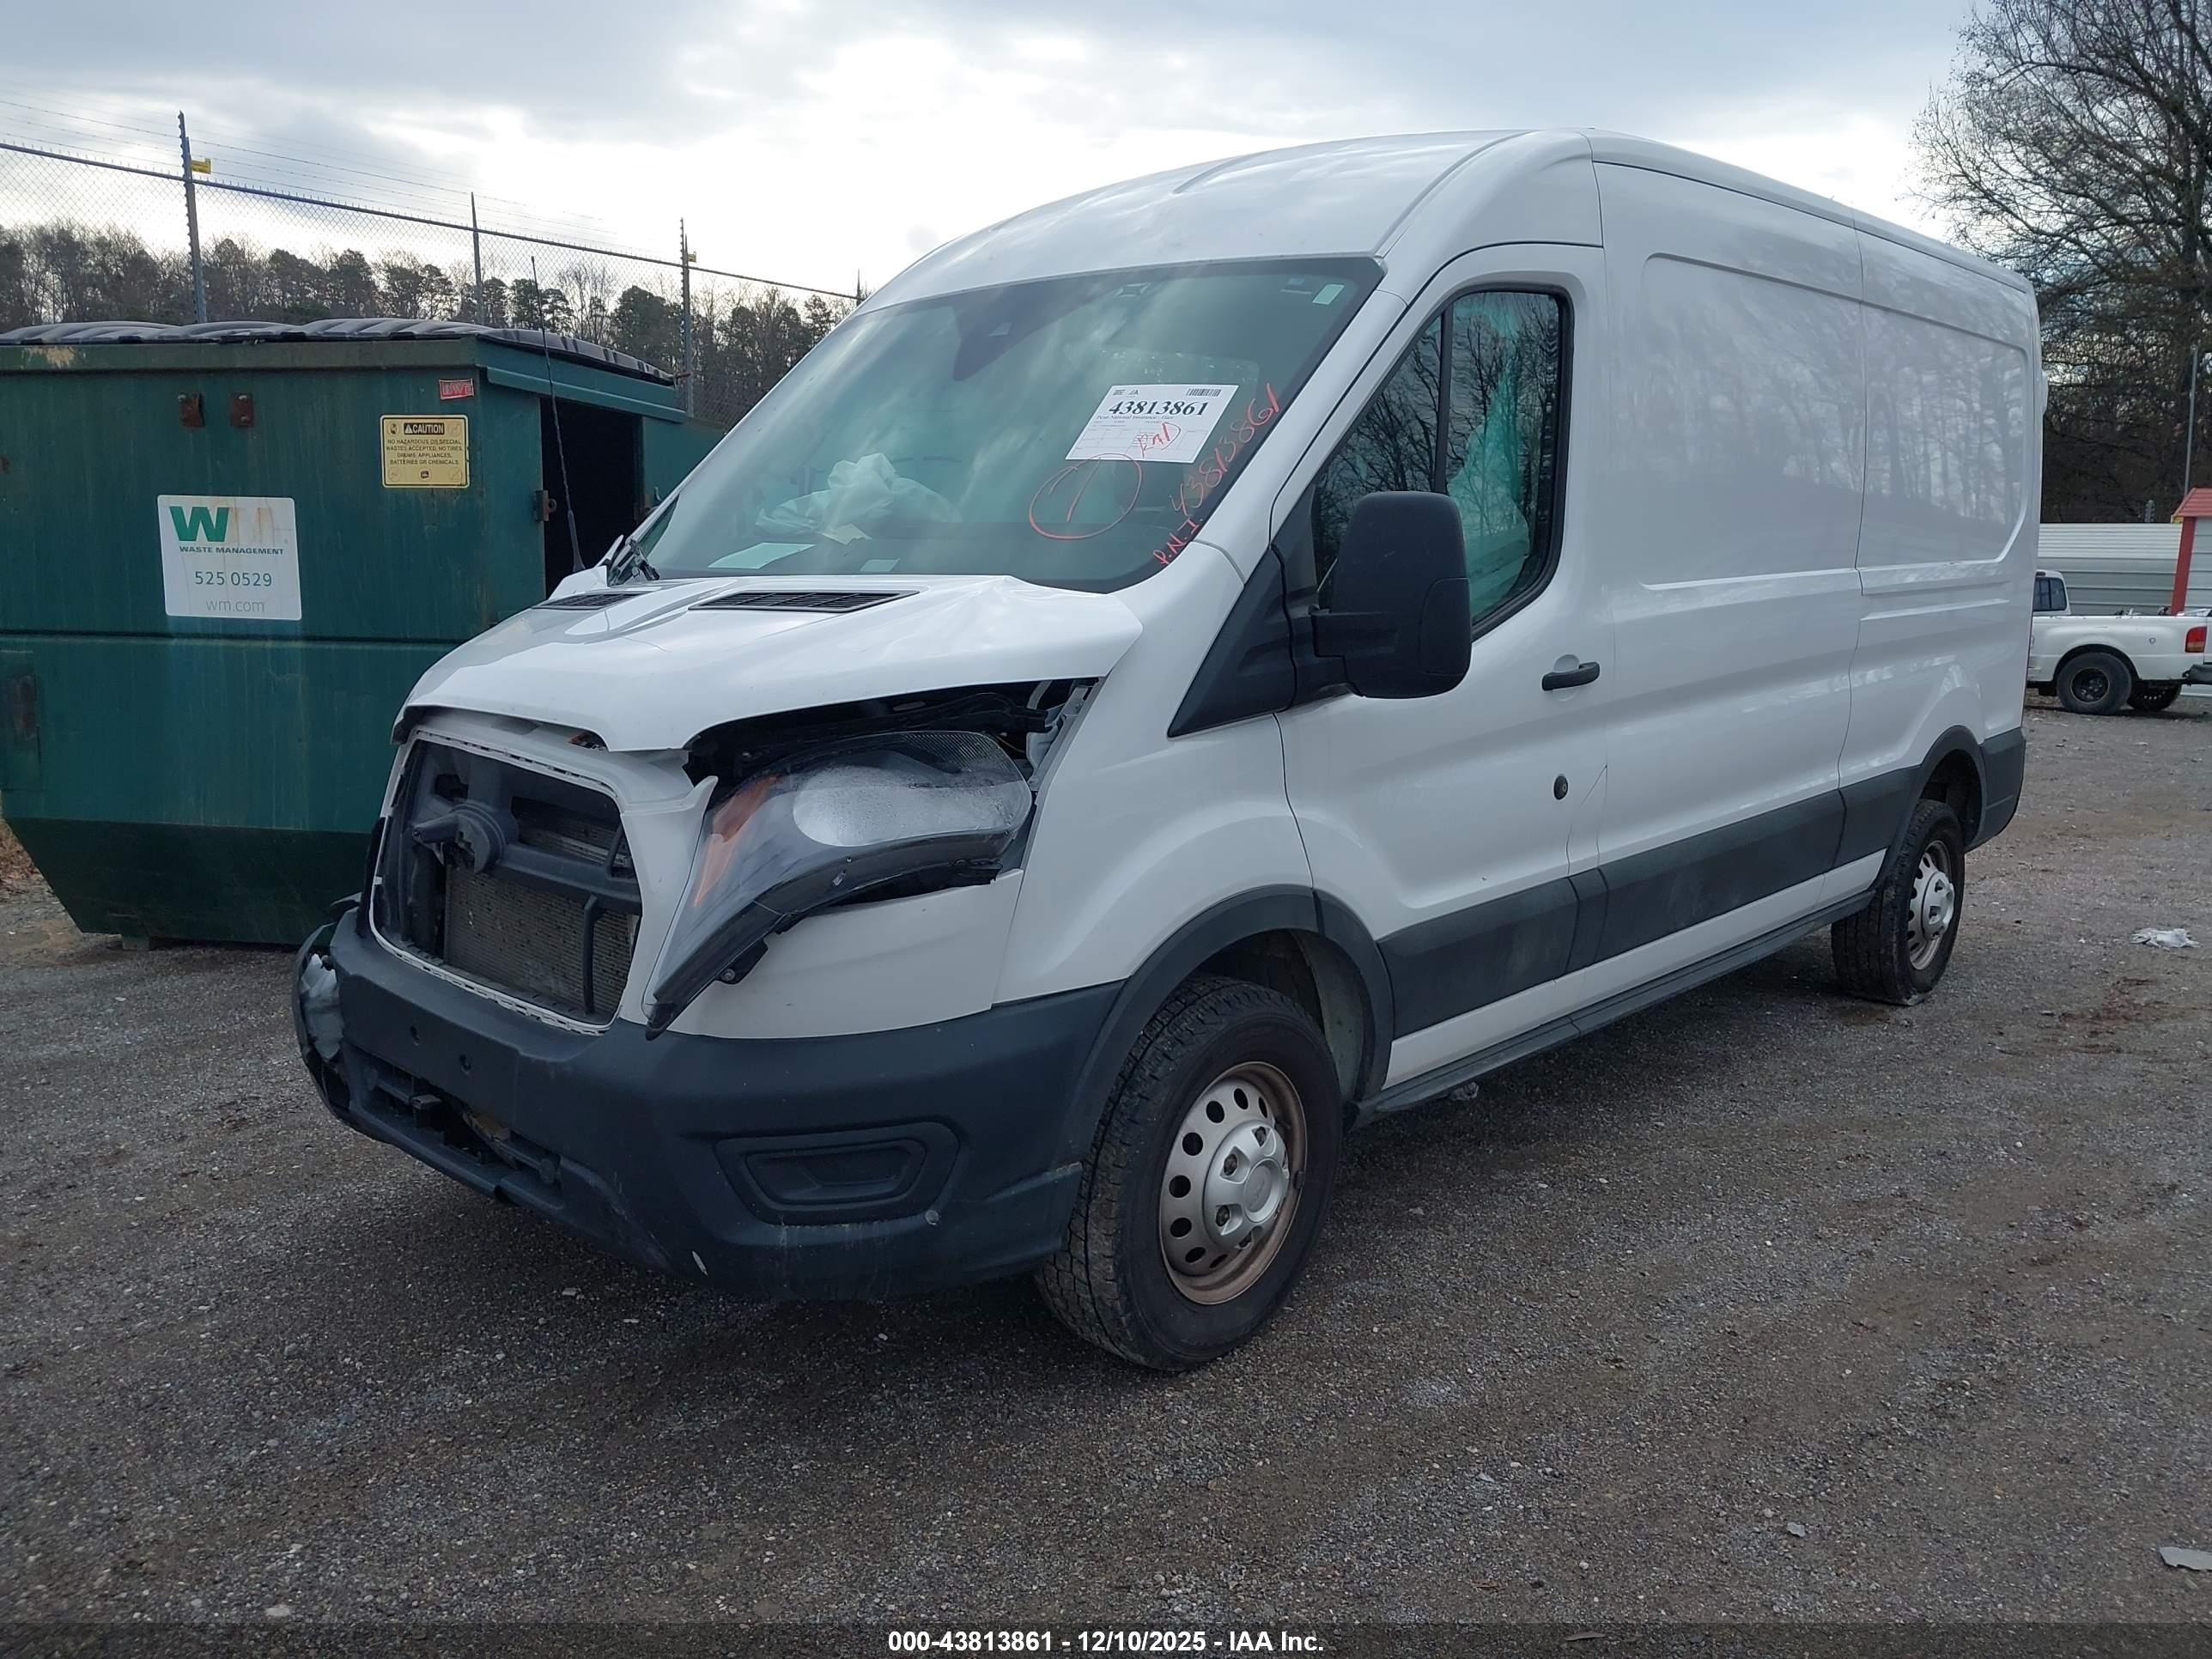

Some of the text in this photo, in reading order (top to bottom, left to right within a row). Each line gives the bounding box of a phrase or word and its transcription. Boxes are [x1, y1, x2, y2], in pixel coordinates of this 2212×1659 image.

[1108, 400, 1210, 416] 43813861
[412, 423, 444, 434] CAUTION
[1170, 383, 1280, 517] 43813861
[179, 545, 213, 554] WASTE
[195, 571, 272, 586] 525 0529
[206, 600, 265, 612] wm.com
